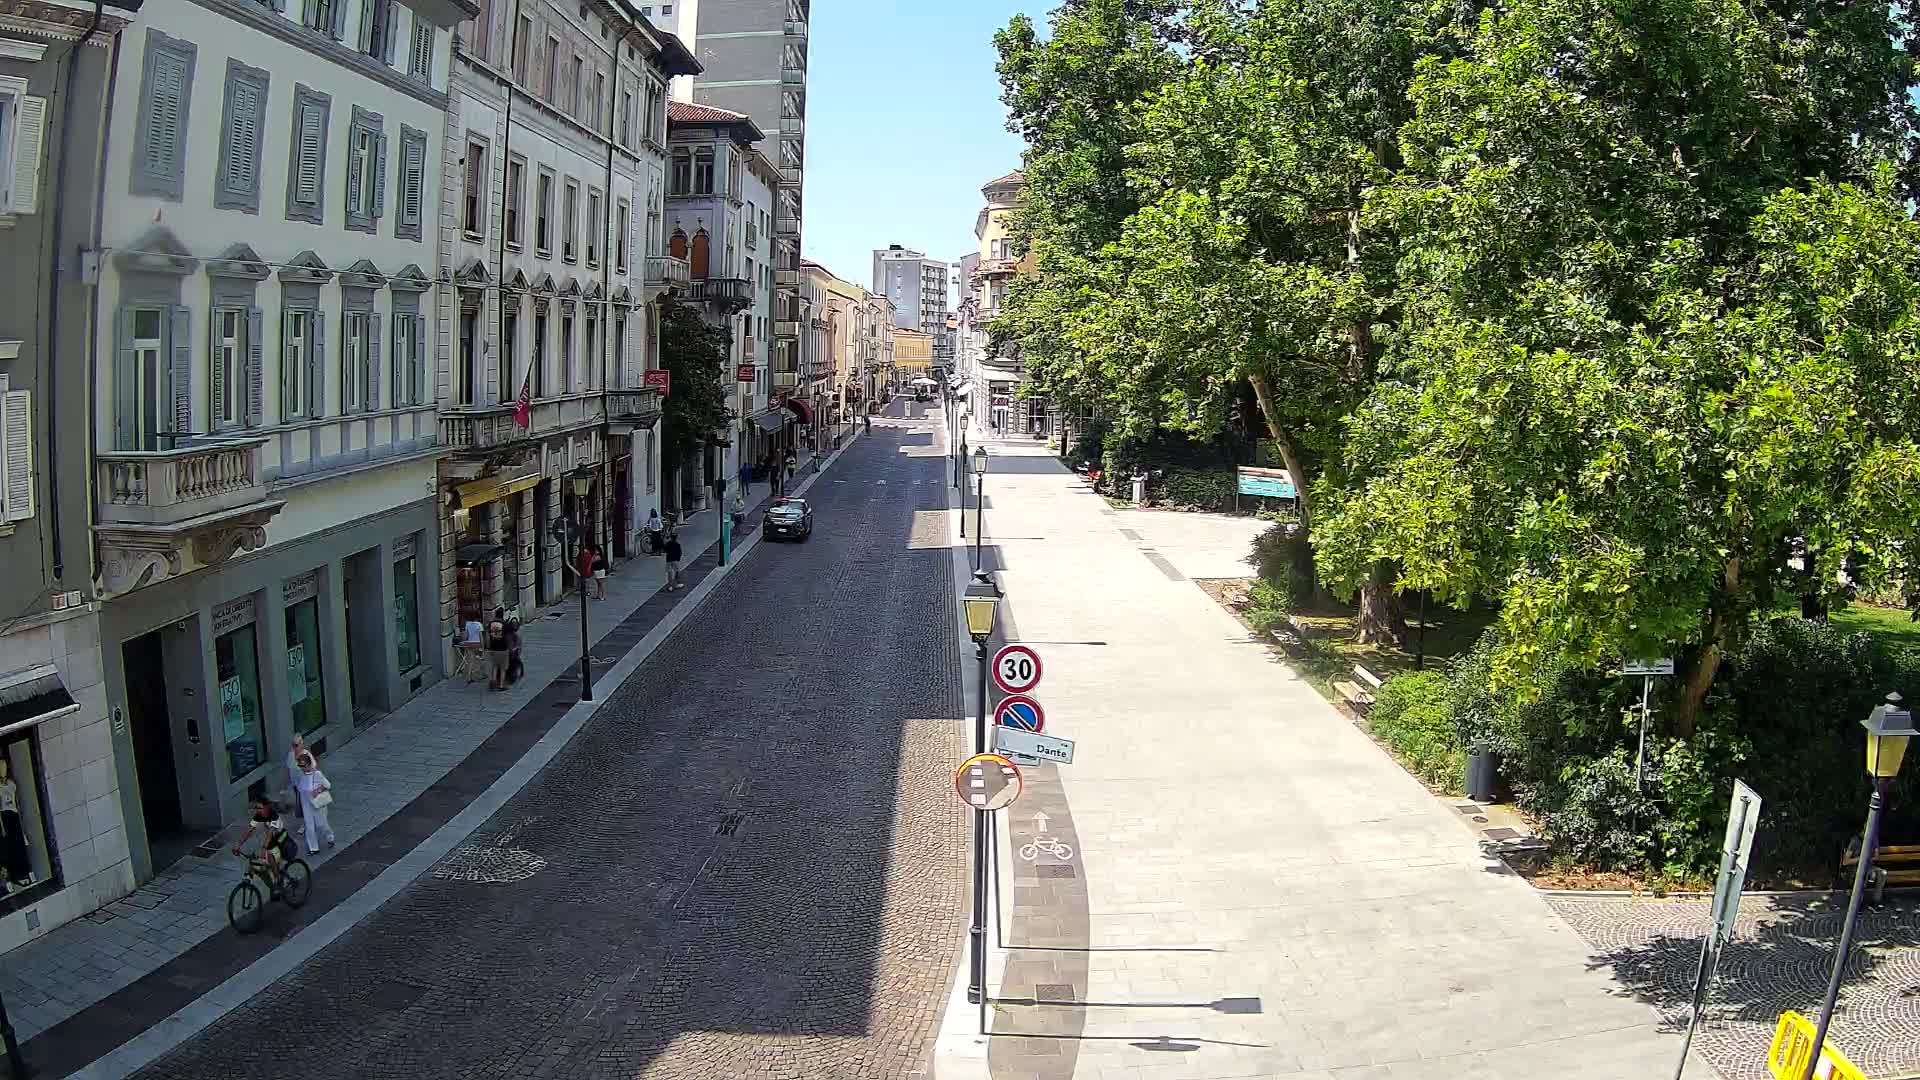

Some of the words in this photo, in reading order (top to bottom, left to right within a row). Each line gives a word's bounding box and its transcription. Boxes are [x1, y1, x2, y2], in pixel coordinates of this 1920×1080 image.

[1005, 659, 1031, 680] 30
[223, 679, 240, 702] 130
[1036, 744, 1067, 757] Dante
